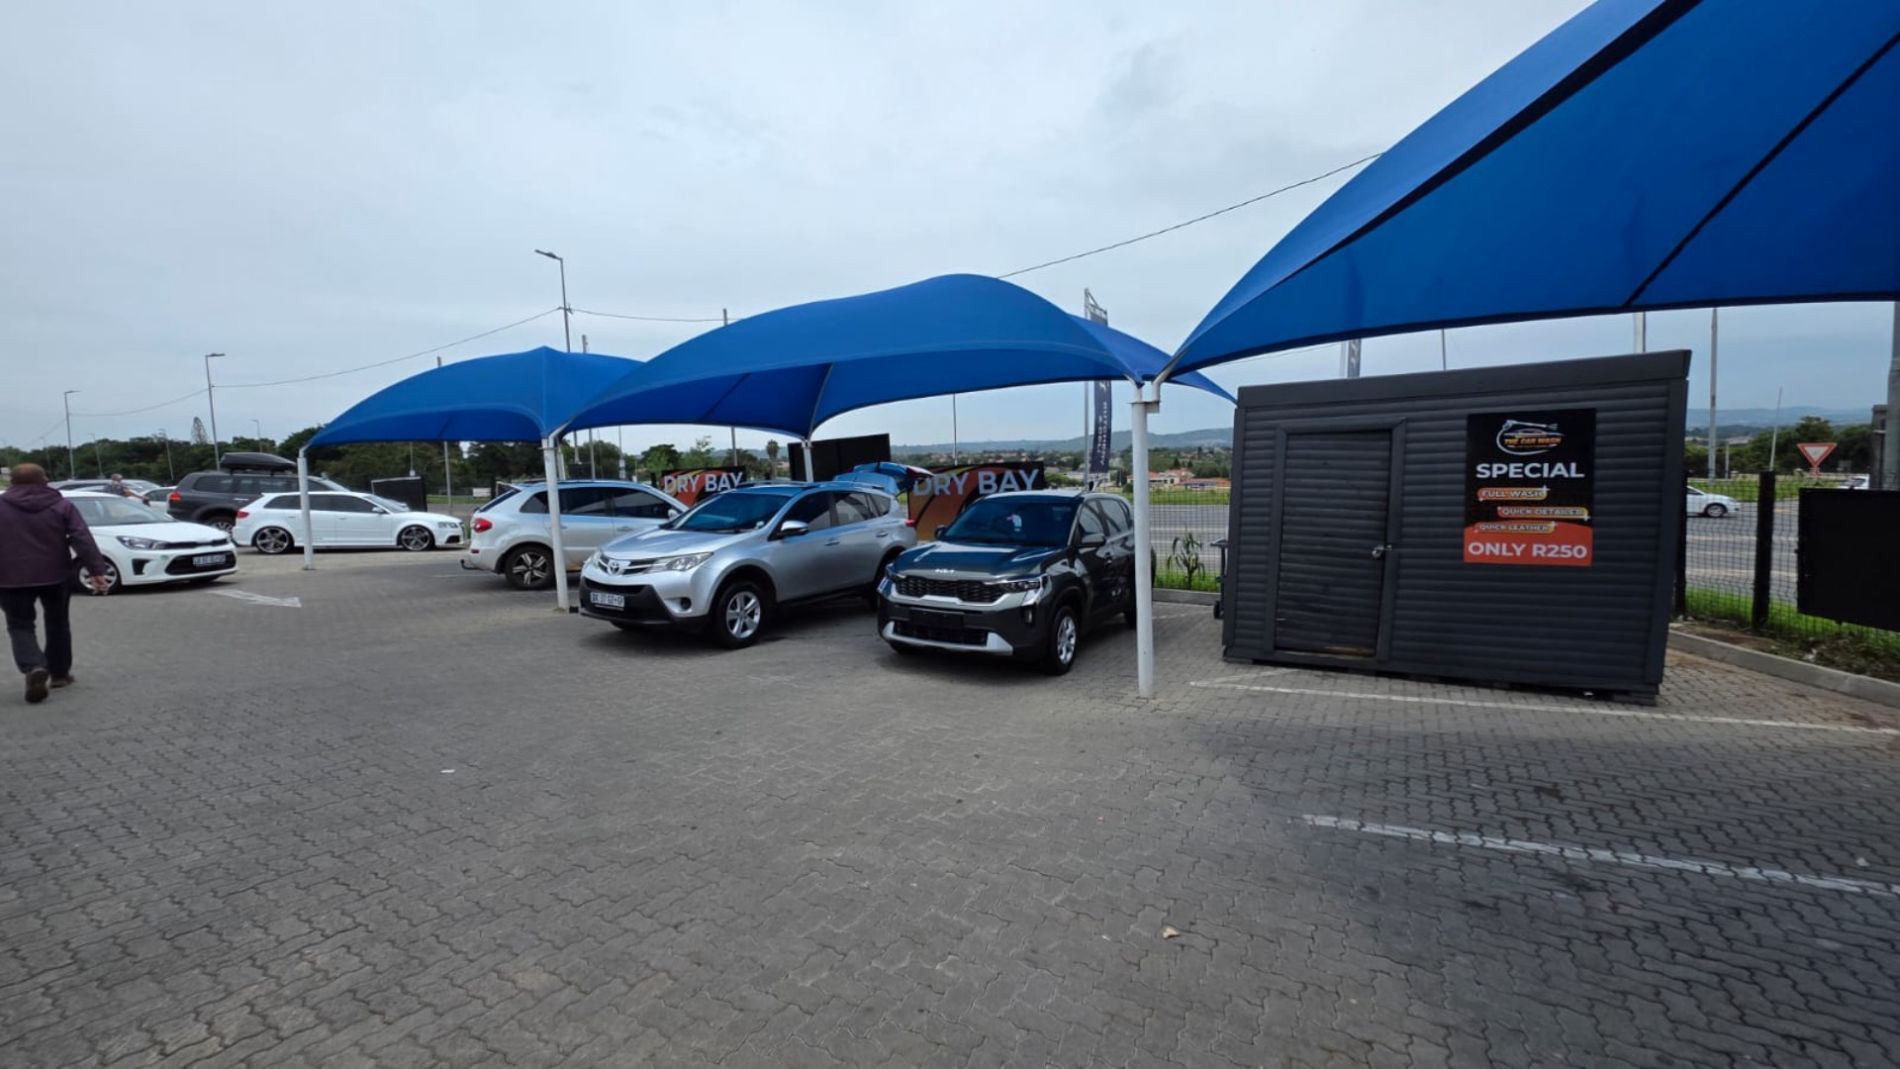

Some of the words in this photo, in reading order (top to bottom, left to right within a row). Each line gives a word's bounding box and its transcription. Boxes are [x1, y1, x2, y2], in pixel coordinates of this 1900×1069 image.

[1476, 462, 1585, 479] SPECIAL
[664, 474, 700, 493] DRY
[705, 472, 743, 492] BAY
[913, 471, 970, 496] DRY
[978, 469, 1039, 495] BAY
[1482, 490, 1506, 498] FULL
[1510, 490, 1543, 498] WASH
[1468, 542, 1526, 557] ONLY
[1532, 543, 1588, 558] R250
